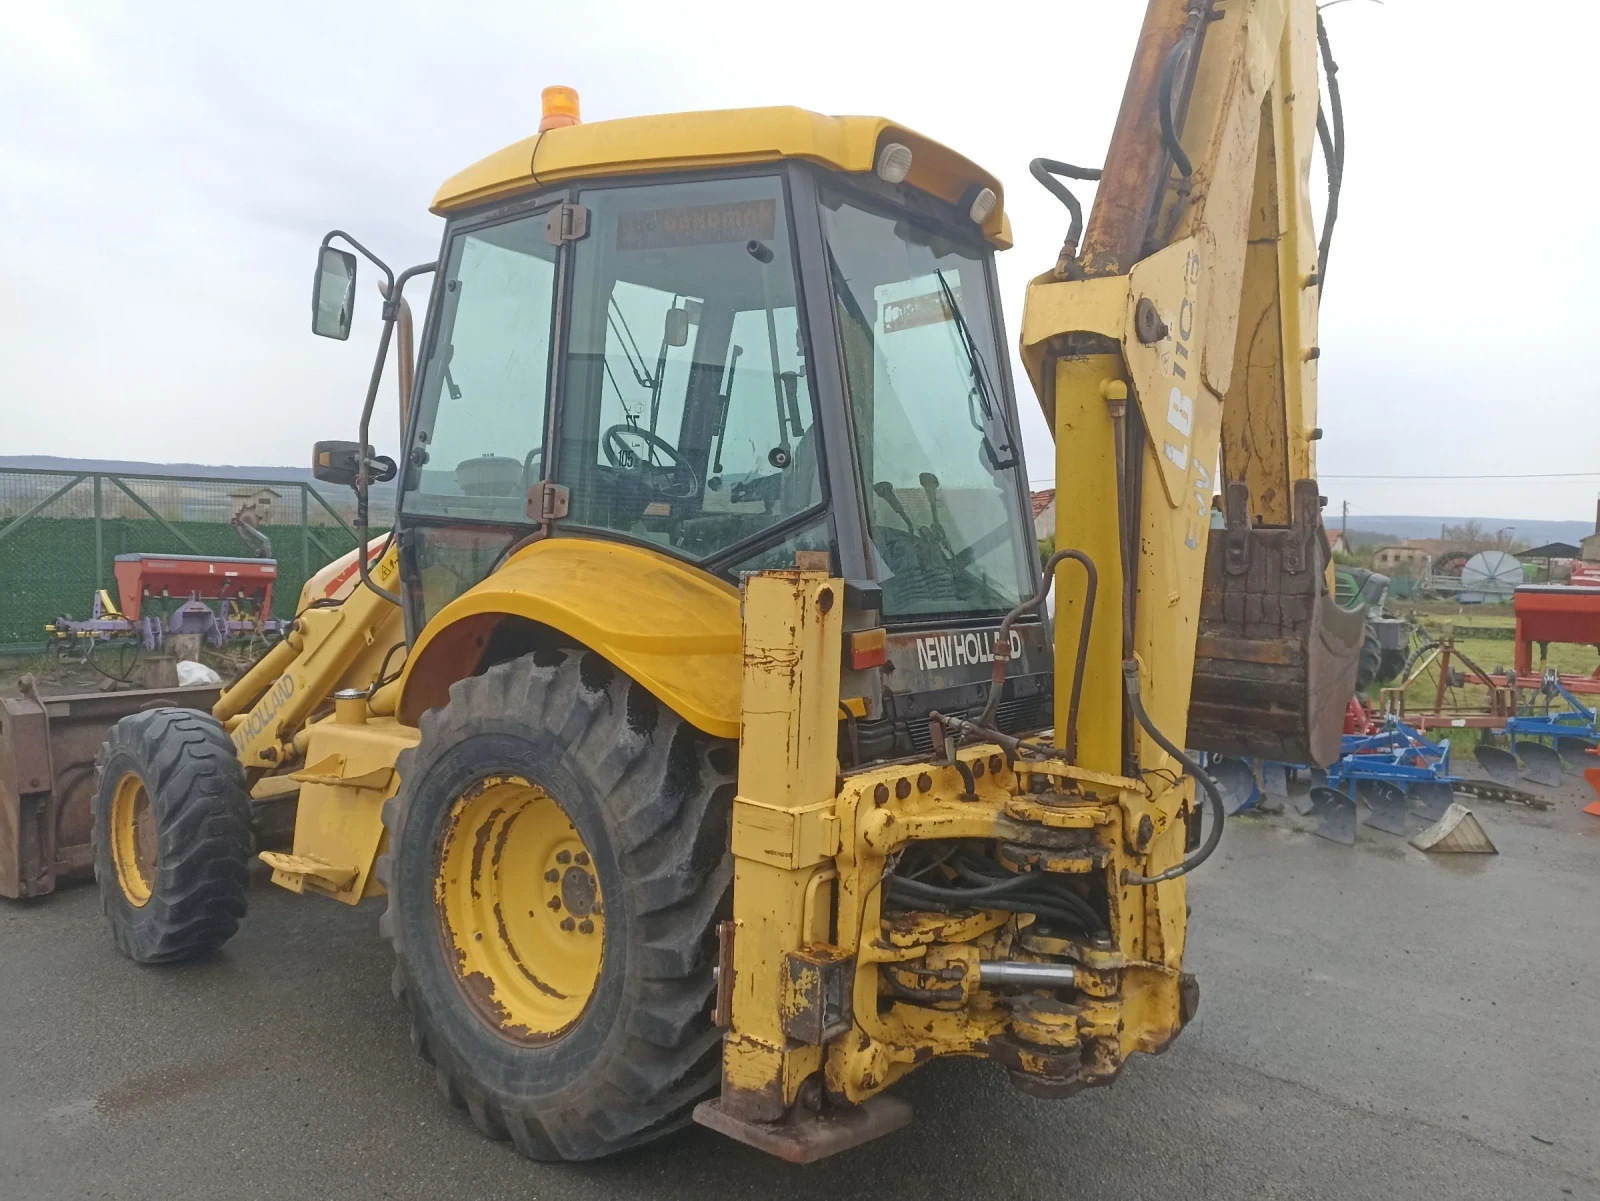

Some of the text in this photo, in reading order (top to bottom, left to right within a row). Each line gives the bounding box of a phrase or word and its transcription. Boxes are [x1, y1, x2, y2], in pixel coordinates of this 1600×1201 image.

[618, 449, 634, 468] 105
[916, 630, 1022, 671] NEW HOLLD
[243, 673, 295, 744] HOLLAND
